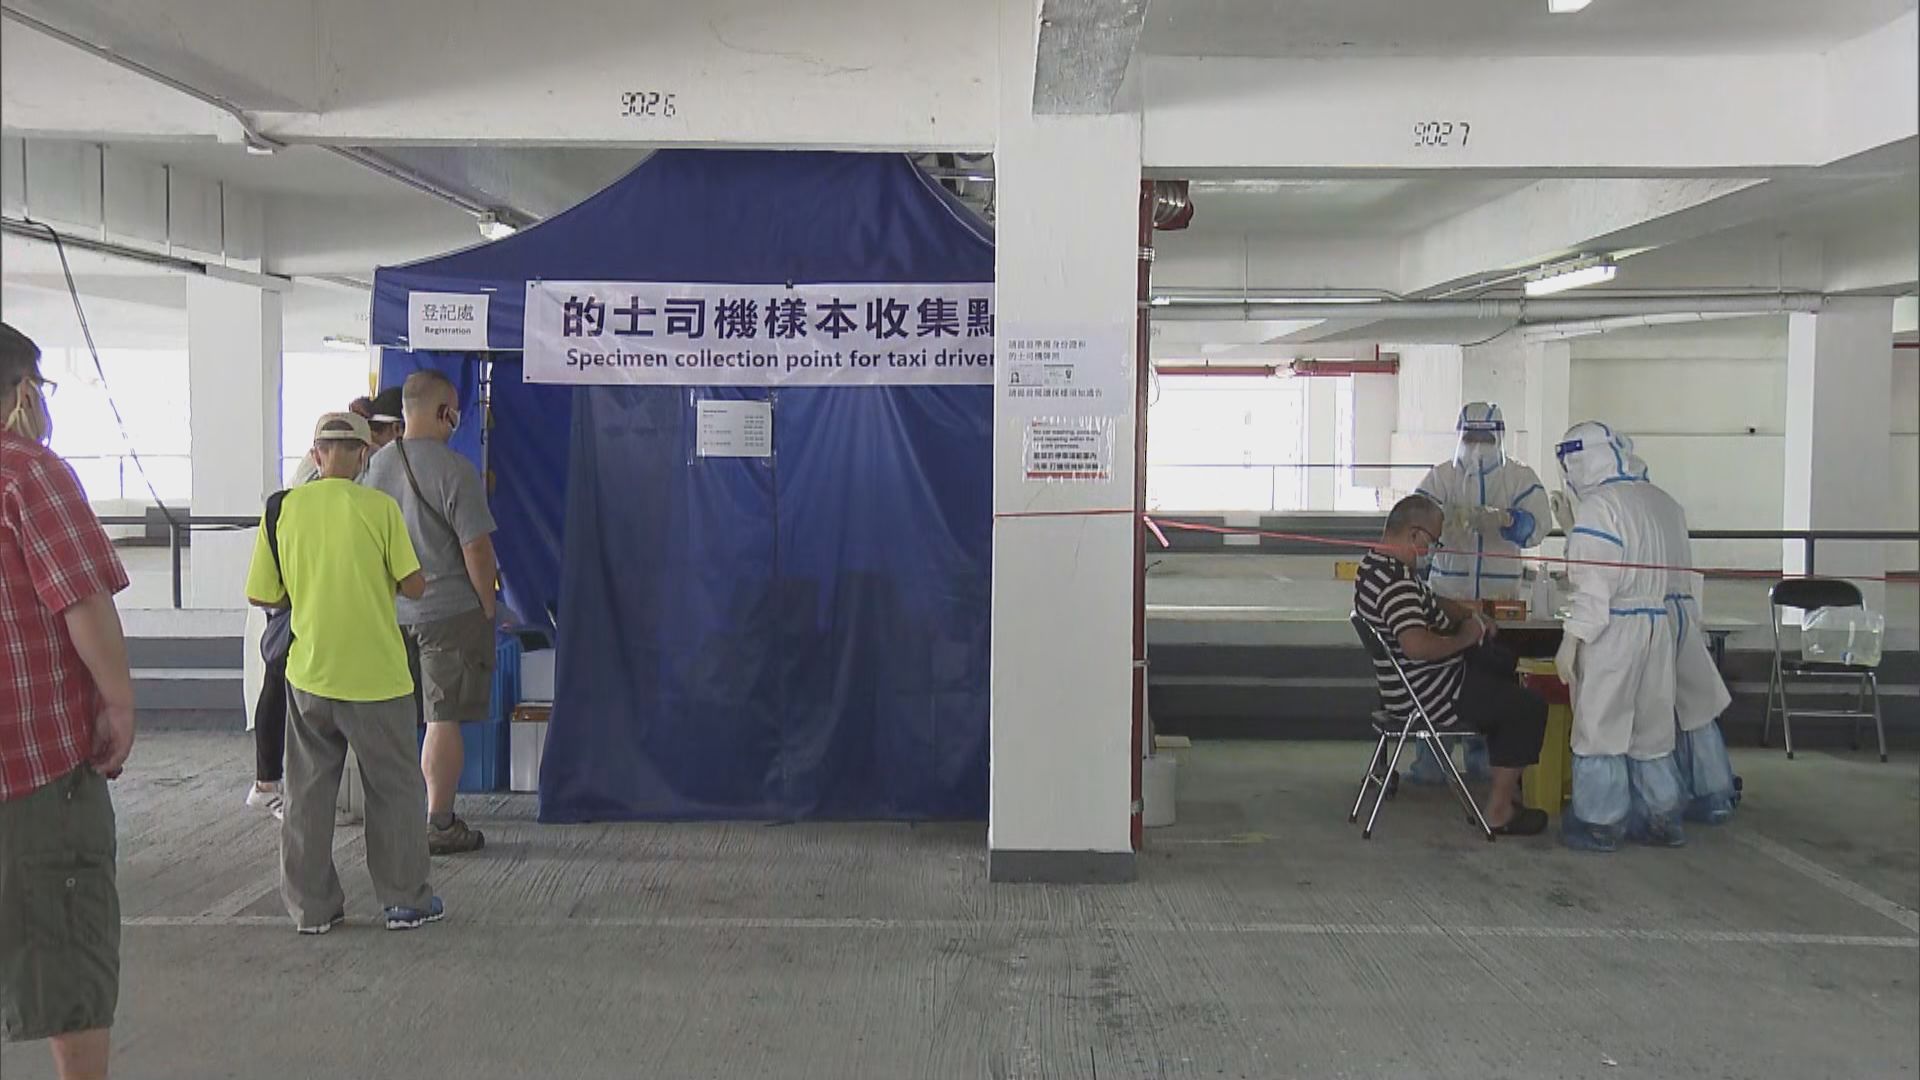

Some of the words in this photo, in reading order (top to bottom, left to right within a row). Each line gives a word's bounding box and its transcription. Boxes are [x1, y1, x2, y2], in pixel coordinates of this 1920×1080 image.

[621, 92, 676, 118] 9026
[1414, 122, 1470, 147] 9027
[422, 304, 474, 321] 登記處
[563, 296, 995, 339] 的士司機樣本收集點
[424, 326, 472, 335] Registration
[566, 348, 667, 370] Specimen
[675, 348, 779, 367] collection
[786, 350, 842, 371] point
[850, 349, 881, 367] for
[889, 350, 927, 367] taxi
